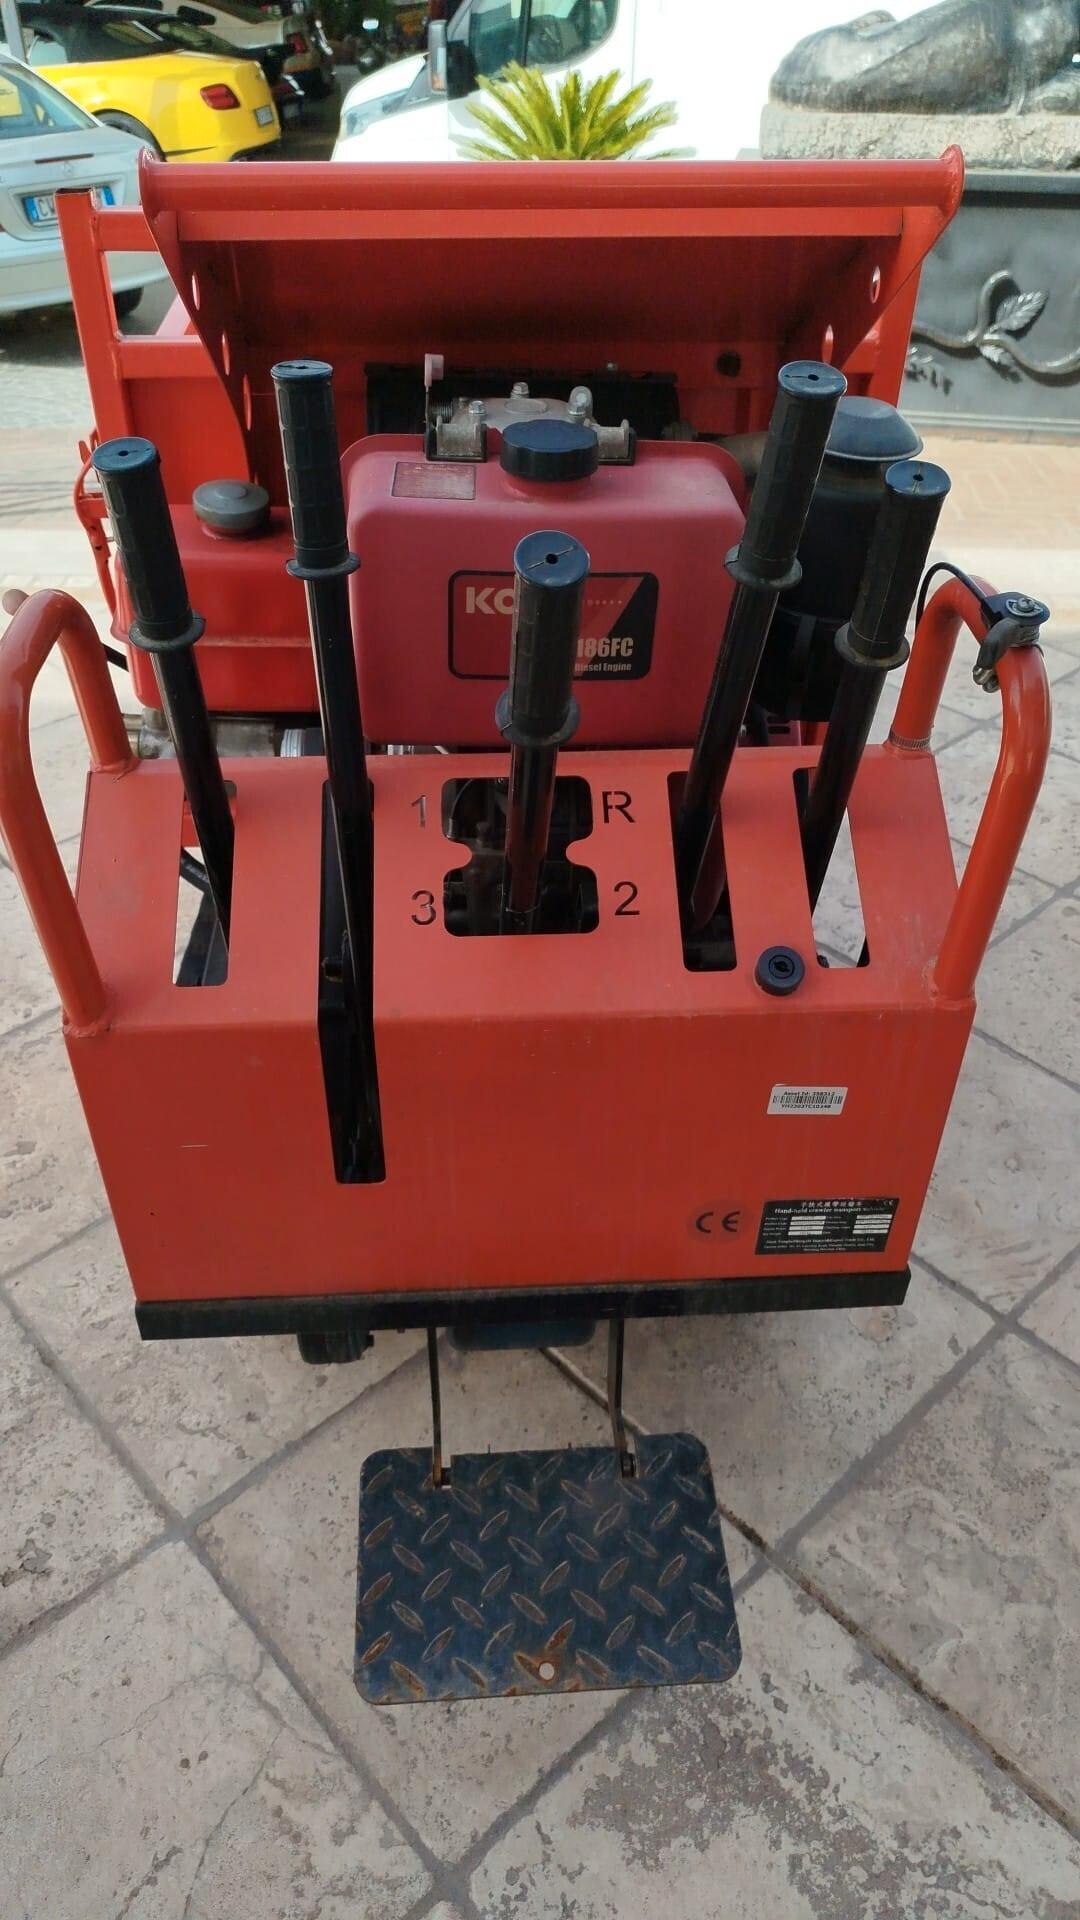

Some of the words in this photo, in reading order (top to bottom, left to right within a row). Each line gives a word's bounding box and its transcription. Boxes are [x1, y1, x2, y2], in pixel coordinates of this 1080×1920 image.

[576, 637, 634, 658] 186FC
[574, 662, 602, 673] Diesel
[603, 662, 632, 673] Engine
[411, 794, 428, 828] 1
[602, 790, 636, 823] R
[411, 889, 437, 926] 3
[613, 880, 641, 916] 2
[694, 1210, 741, 1234] CE
